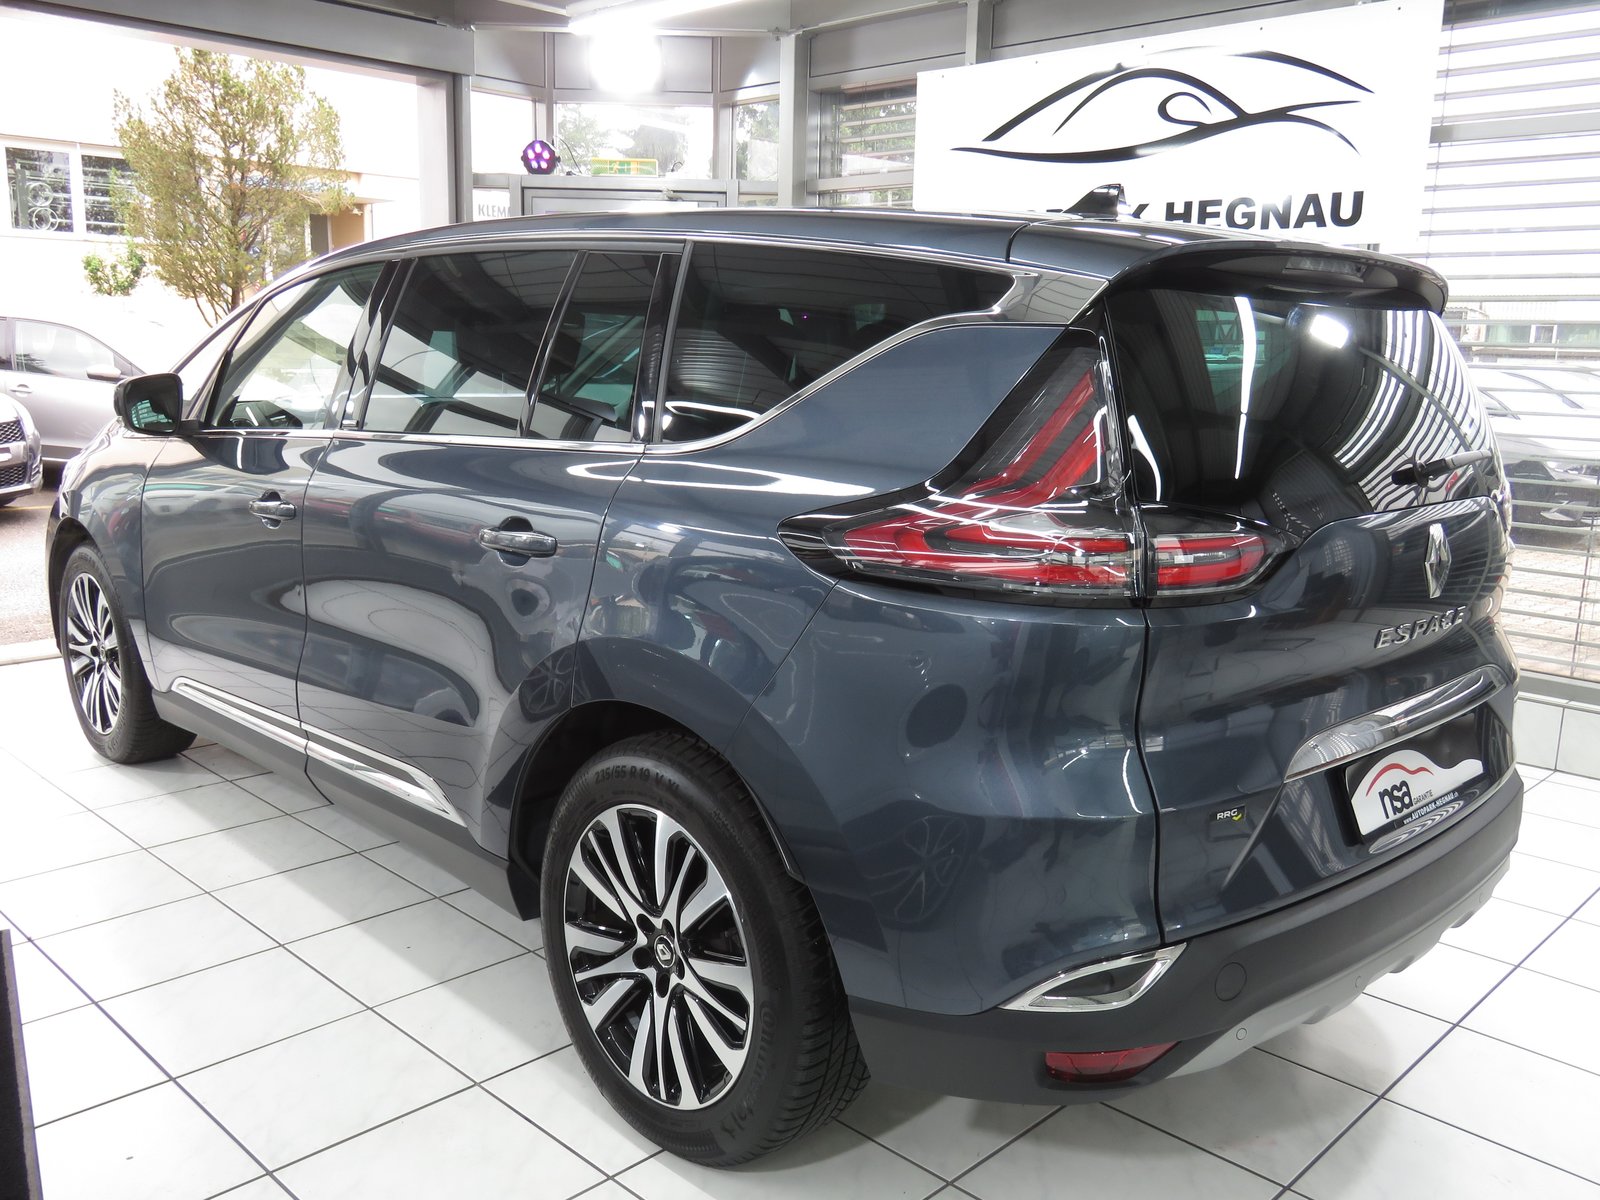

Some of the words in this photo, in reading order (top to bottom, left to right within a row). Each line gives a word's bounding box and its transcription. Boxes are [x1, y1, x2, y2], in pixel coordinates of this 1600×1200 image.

[1165, 190, 1364, 230] HEGNAU
[1374, 605, 1466, 649] ESPACE
[595, 765, 627, 785] 235/55
[1378, 780, 1414, 820] nsa
[1413, 789, 1434, 806] GARANTIE
